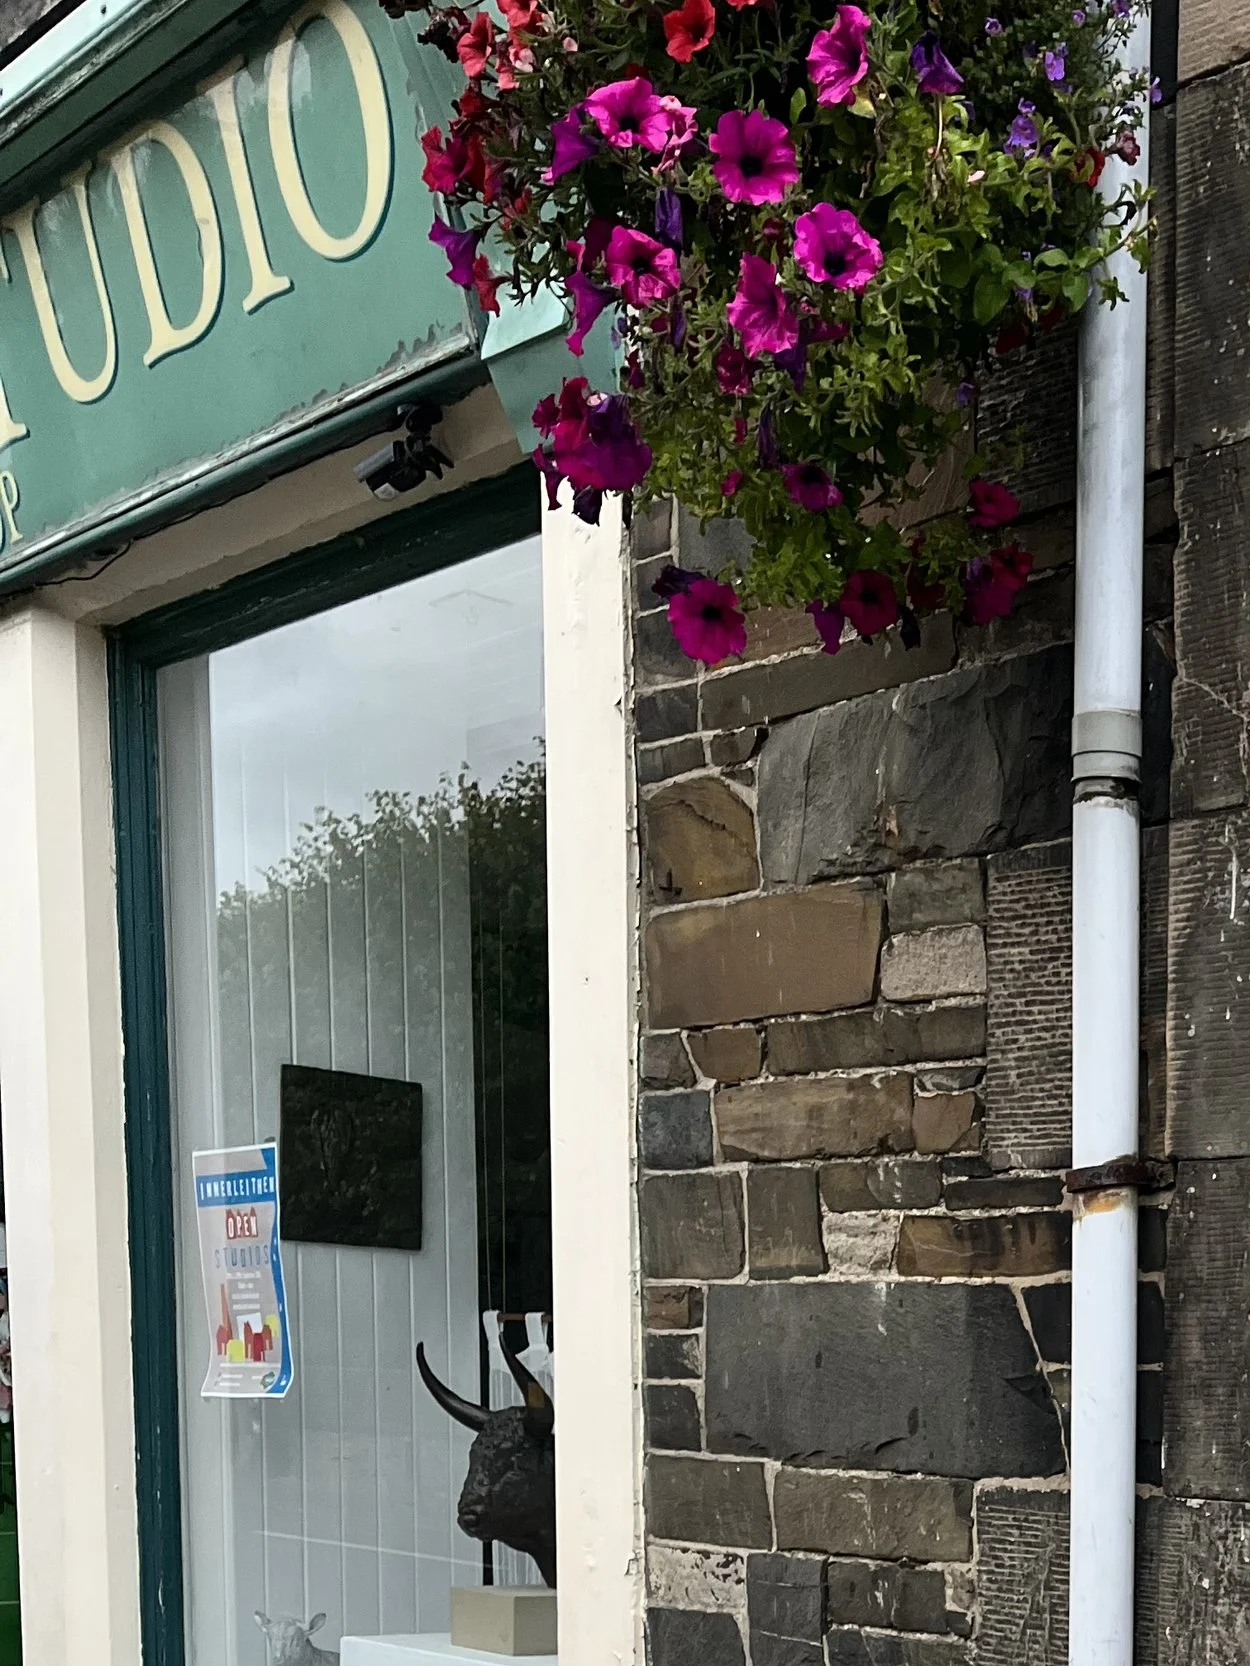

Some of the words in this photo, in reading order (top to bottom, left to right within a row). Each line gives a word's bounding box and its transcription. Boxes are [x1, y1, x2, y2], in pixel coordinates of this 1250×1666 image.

[200, 1177, 275, 1201] INNERLEITHEN
[227, 1215, 257, 1238] OPEN
[215, 1245, 269, 1269] STUDIOS
